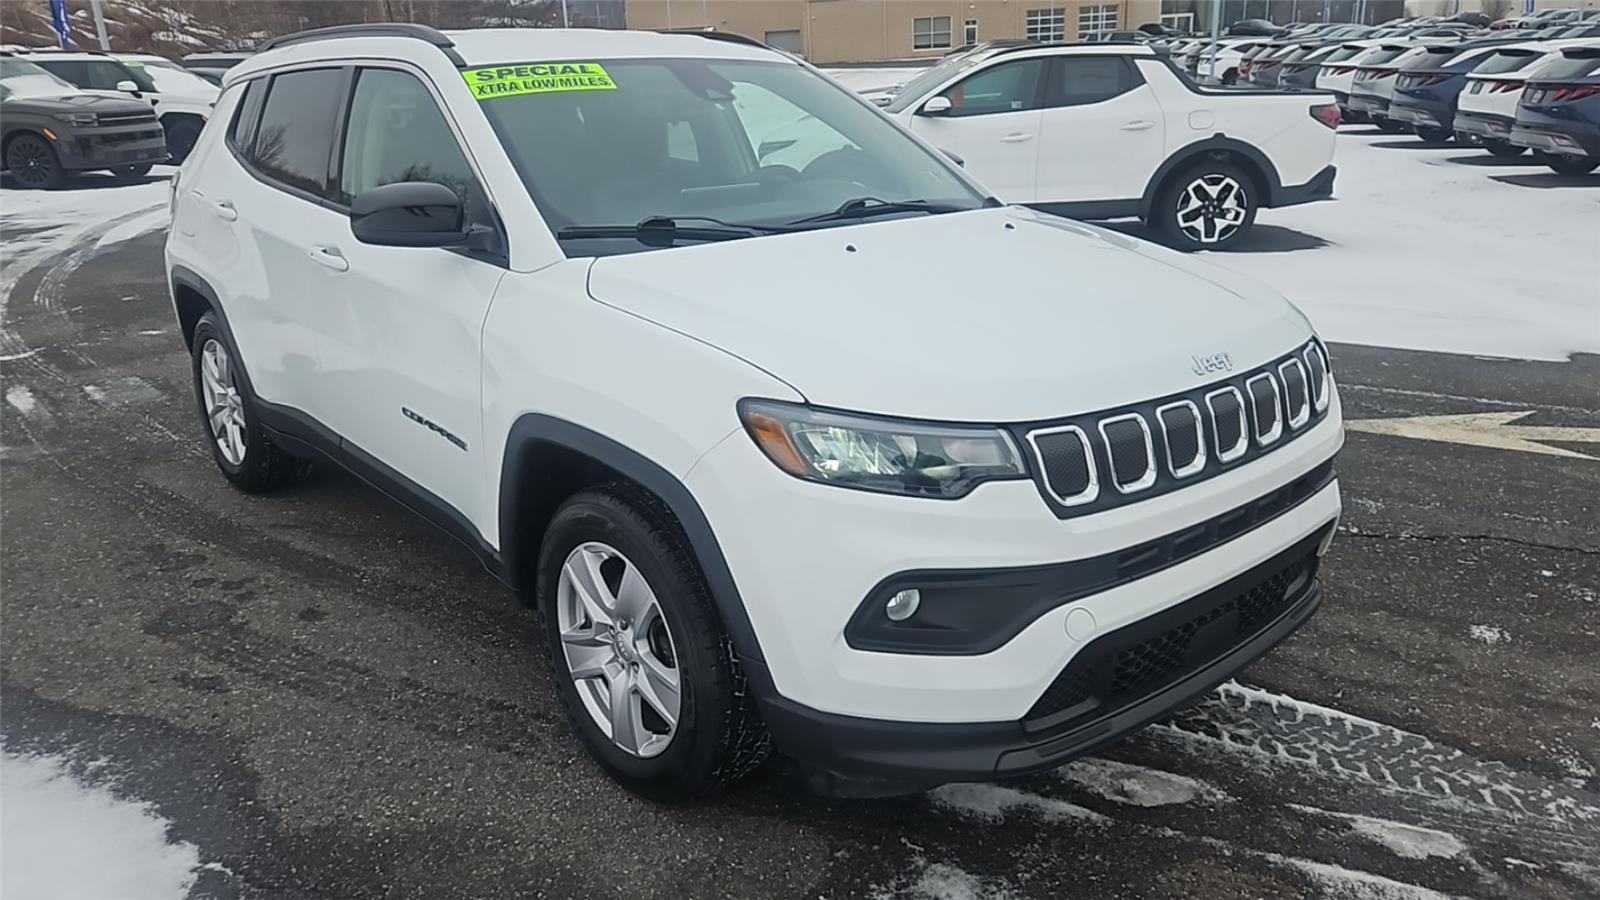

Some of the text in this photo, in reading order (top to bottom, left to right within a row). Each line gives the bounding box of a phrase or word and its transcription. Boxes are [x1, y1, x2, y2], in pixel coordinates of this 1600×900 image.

[476, 65, 596, 82] SPECIAL
[477, 76, 608, 95] XTRA LOW MILES
[1191, 353, 1233, 376] Jeep
